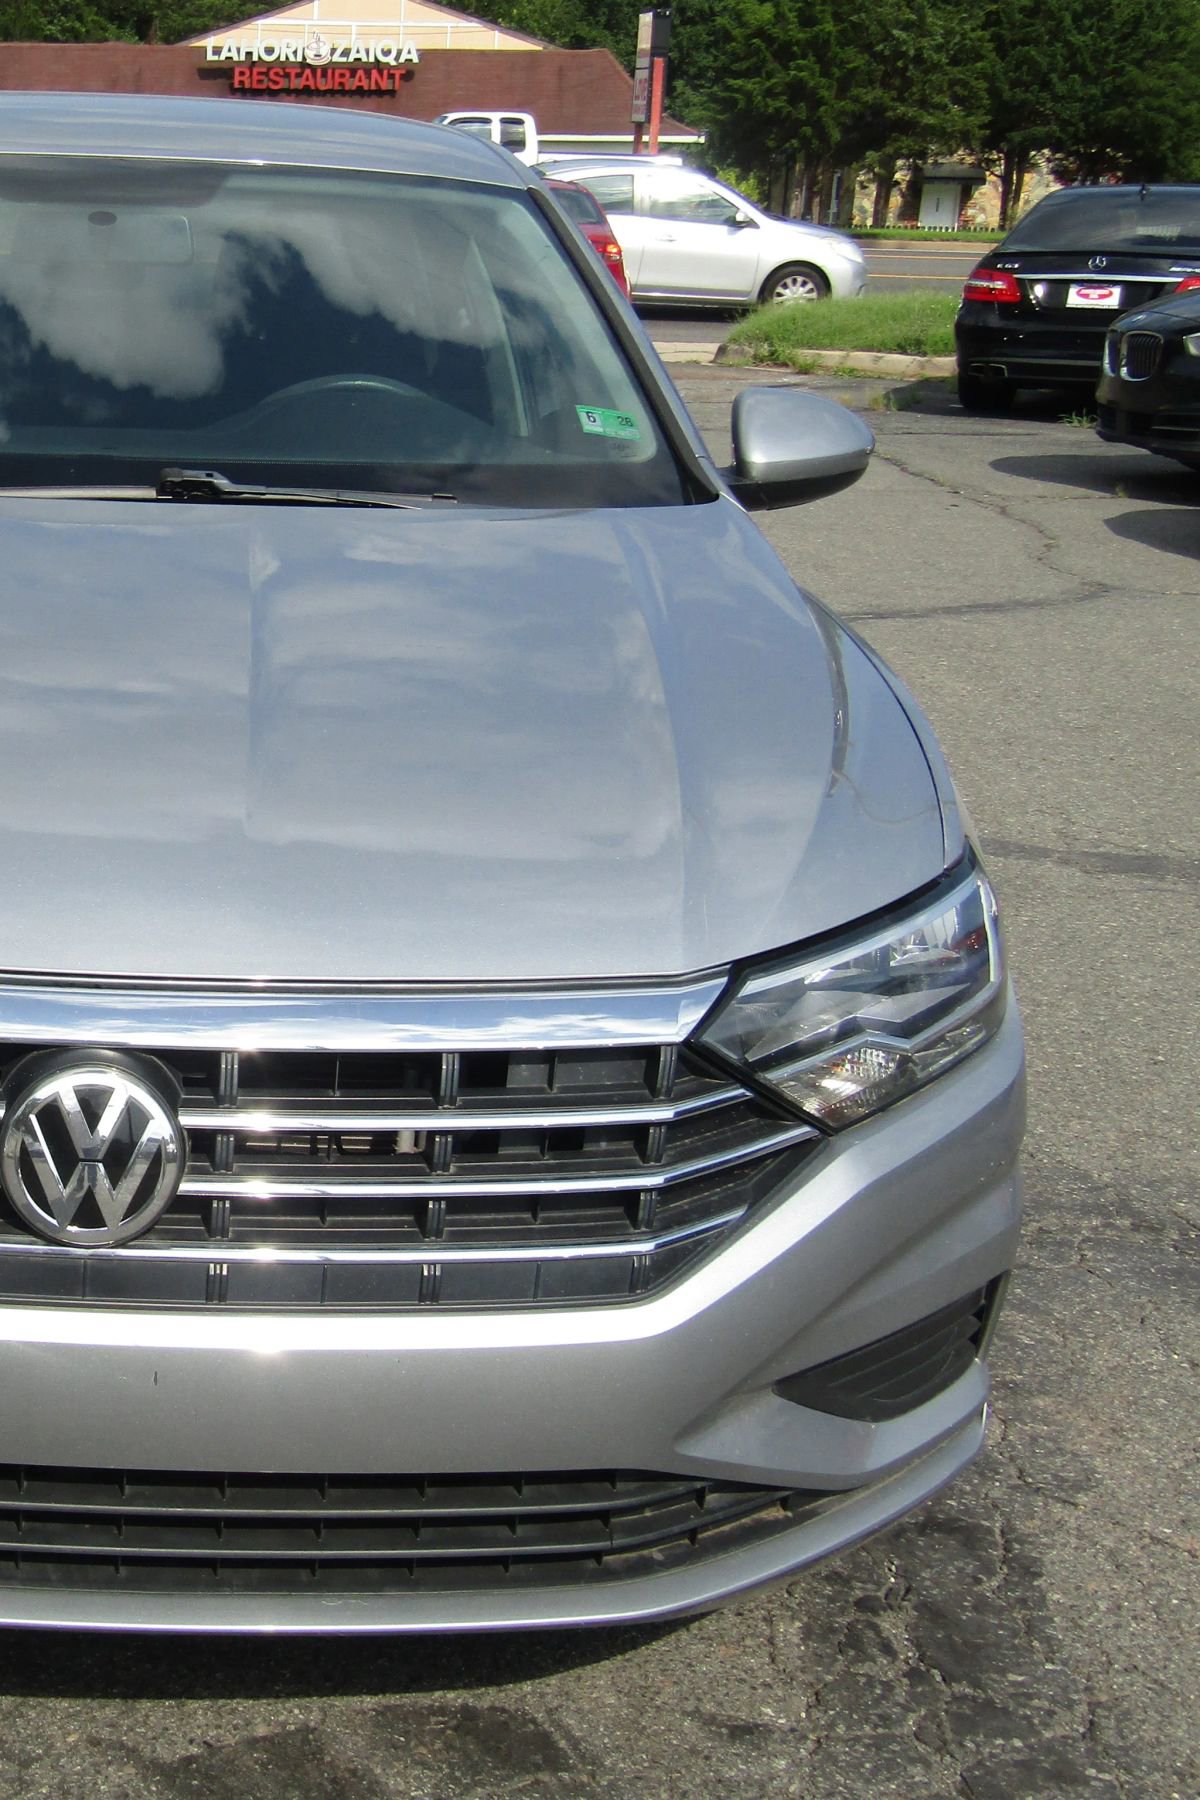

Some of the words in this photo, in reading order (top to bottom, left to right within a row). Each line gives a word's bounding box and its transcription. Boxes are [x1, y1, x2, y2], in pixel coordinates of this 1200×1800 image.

[206, 36, 304, 62] LAHORI
[331, 38, 420, 65] ZAIQA
[233, 66, 406, 91] RESTAURANT
